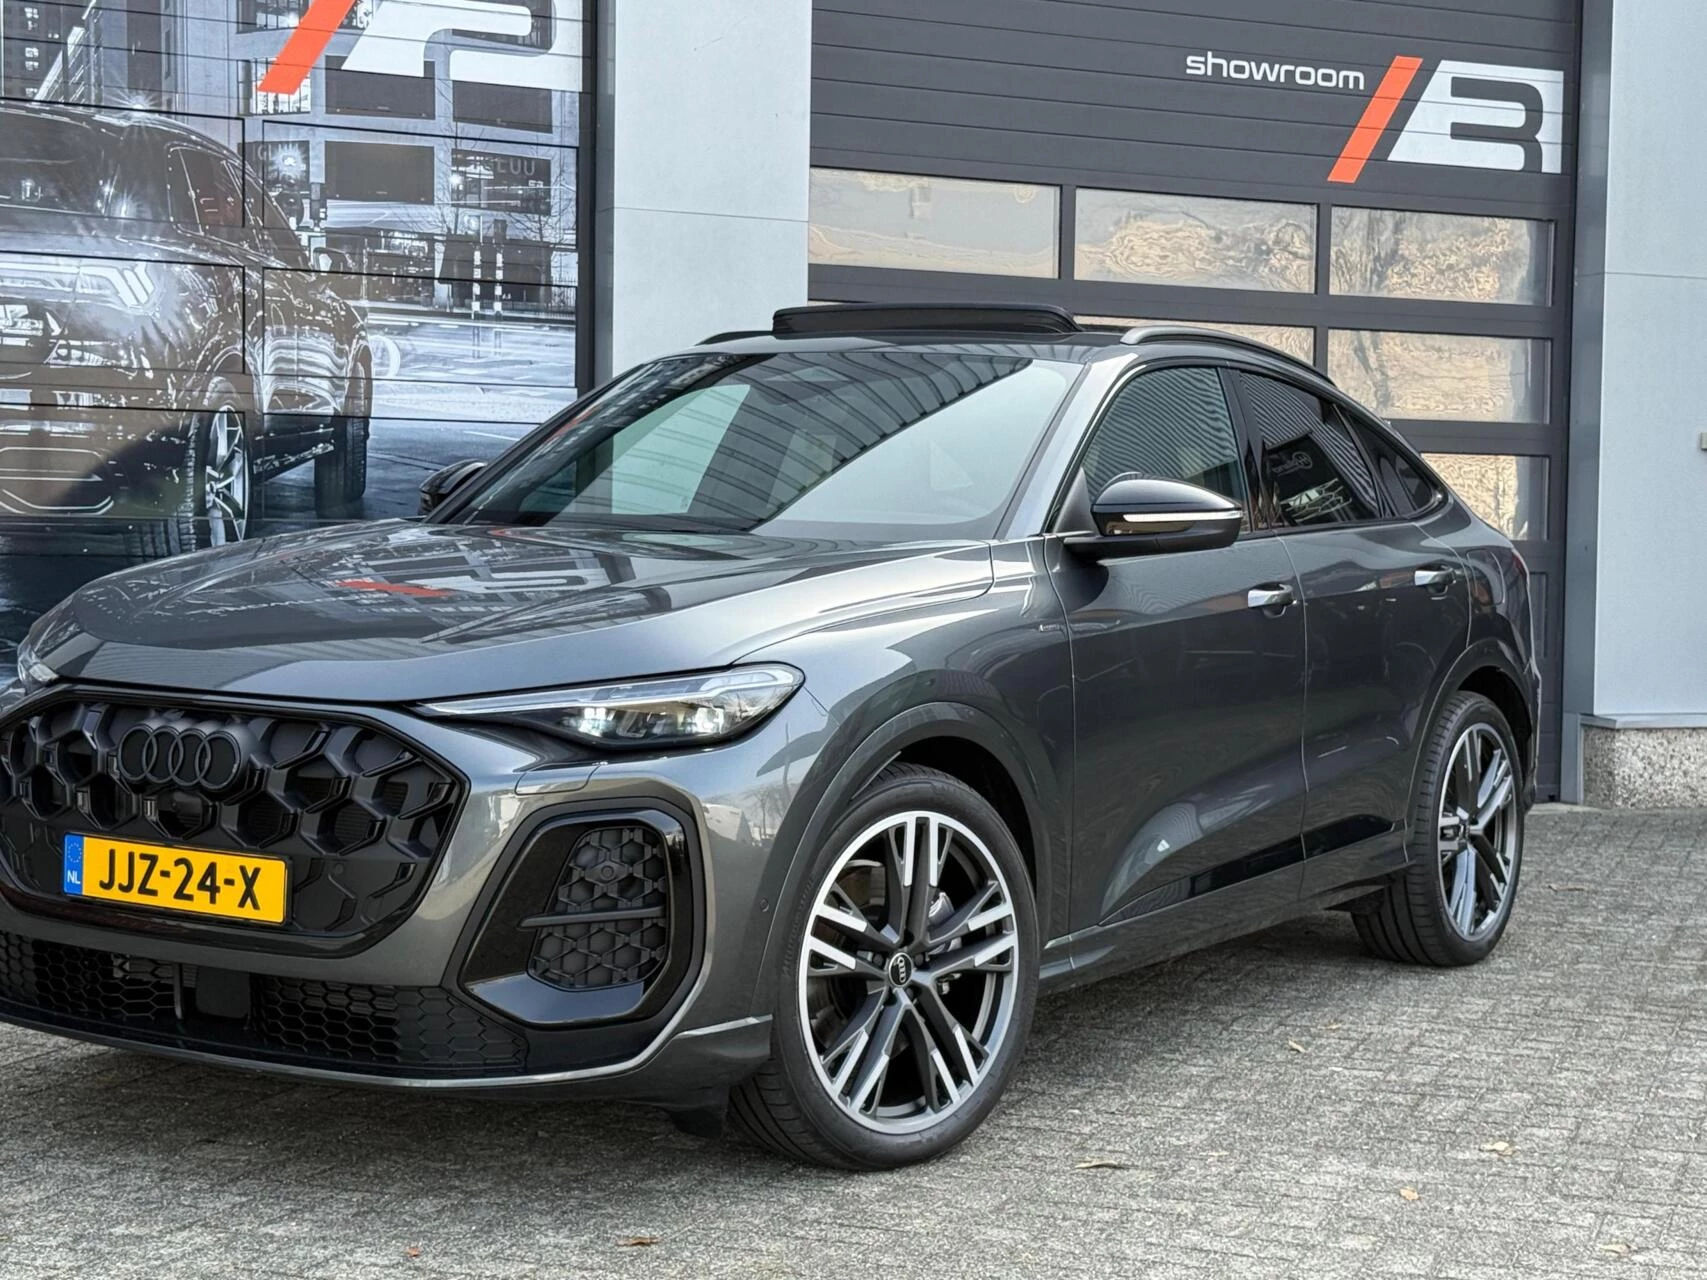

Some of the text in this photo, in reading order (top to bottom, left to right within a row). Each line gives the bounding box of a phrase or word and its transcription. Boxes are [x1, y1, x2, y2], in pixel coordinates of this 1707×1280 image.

[1186, 51, 1365, 90] showroom
[67, 870, 81, 885] NL
[99, 849, 261, 911] JJZ-24-X
